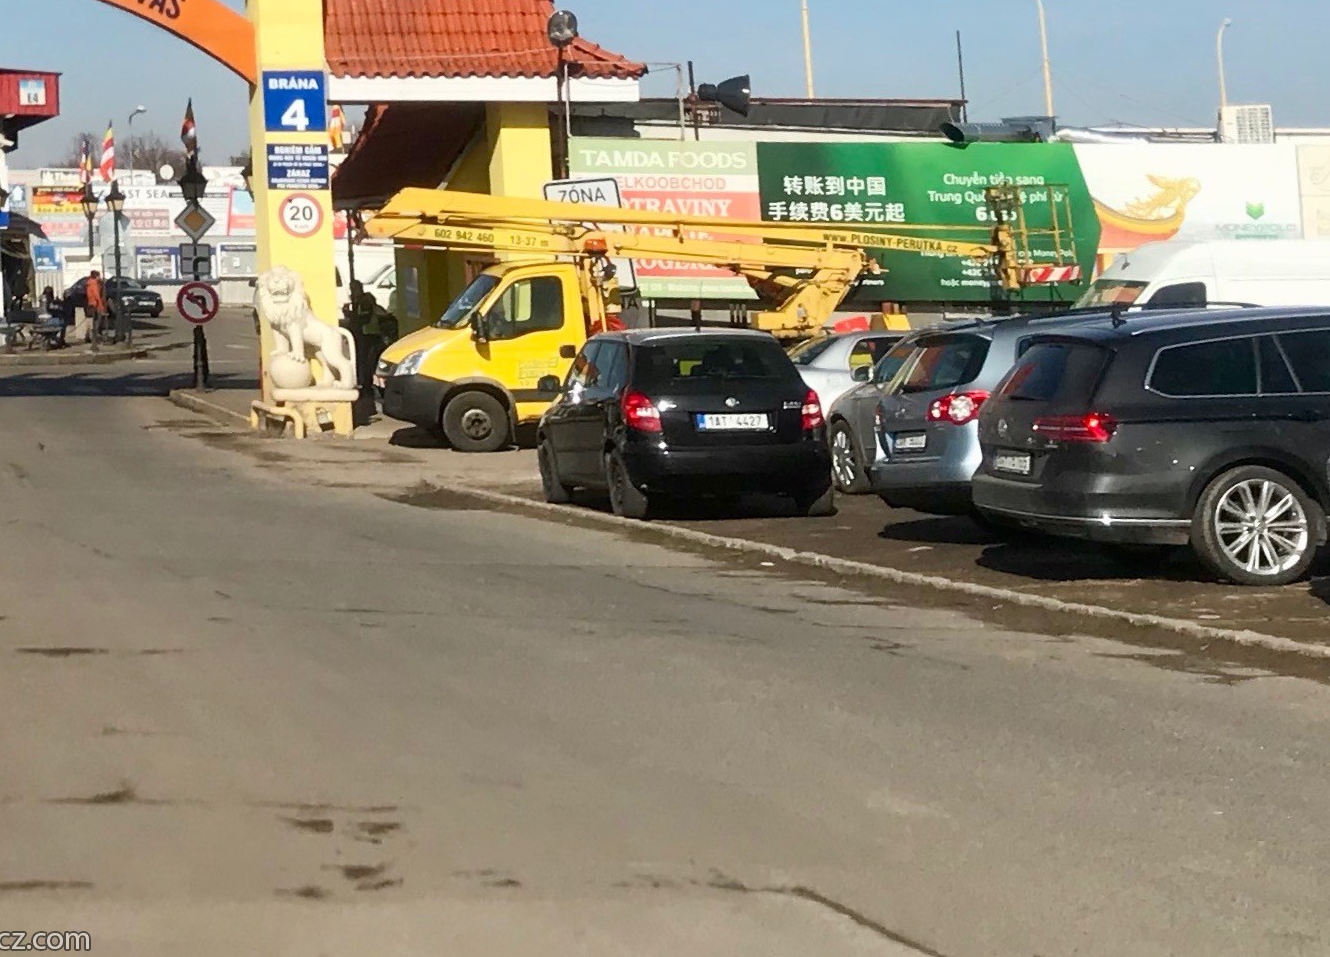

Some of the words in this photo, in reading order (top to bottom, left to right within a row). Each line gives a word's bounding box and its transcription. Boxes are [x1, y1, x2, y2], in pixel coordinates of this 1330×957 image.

[268, 76, 319, 90] BRÁNA
[281, 99, 310, 131] 4
[579, 149, 665, 168] TAMDA
[668, 150, 747, 168] FOODS
[618, 176, 727, 190] ELKOOBCHOD
[783, 175, 887, 196] 转账到中国
[559, 184, 606, 204] ZÓNA
[927, 190, 962, 204] Trung
[290, 206, 313, 221] 20
[622, 197, 732, 217] TRAVINY
[768, 201, 906, 223] 手续费6美元起
[975, 206, 988, 222] 6
[434, 228, 452, 239] 602
[455, 230, 473, 242] 942
[736, 416, 762, 427] 4427
